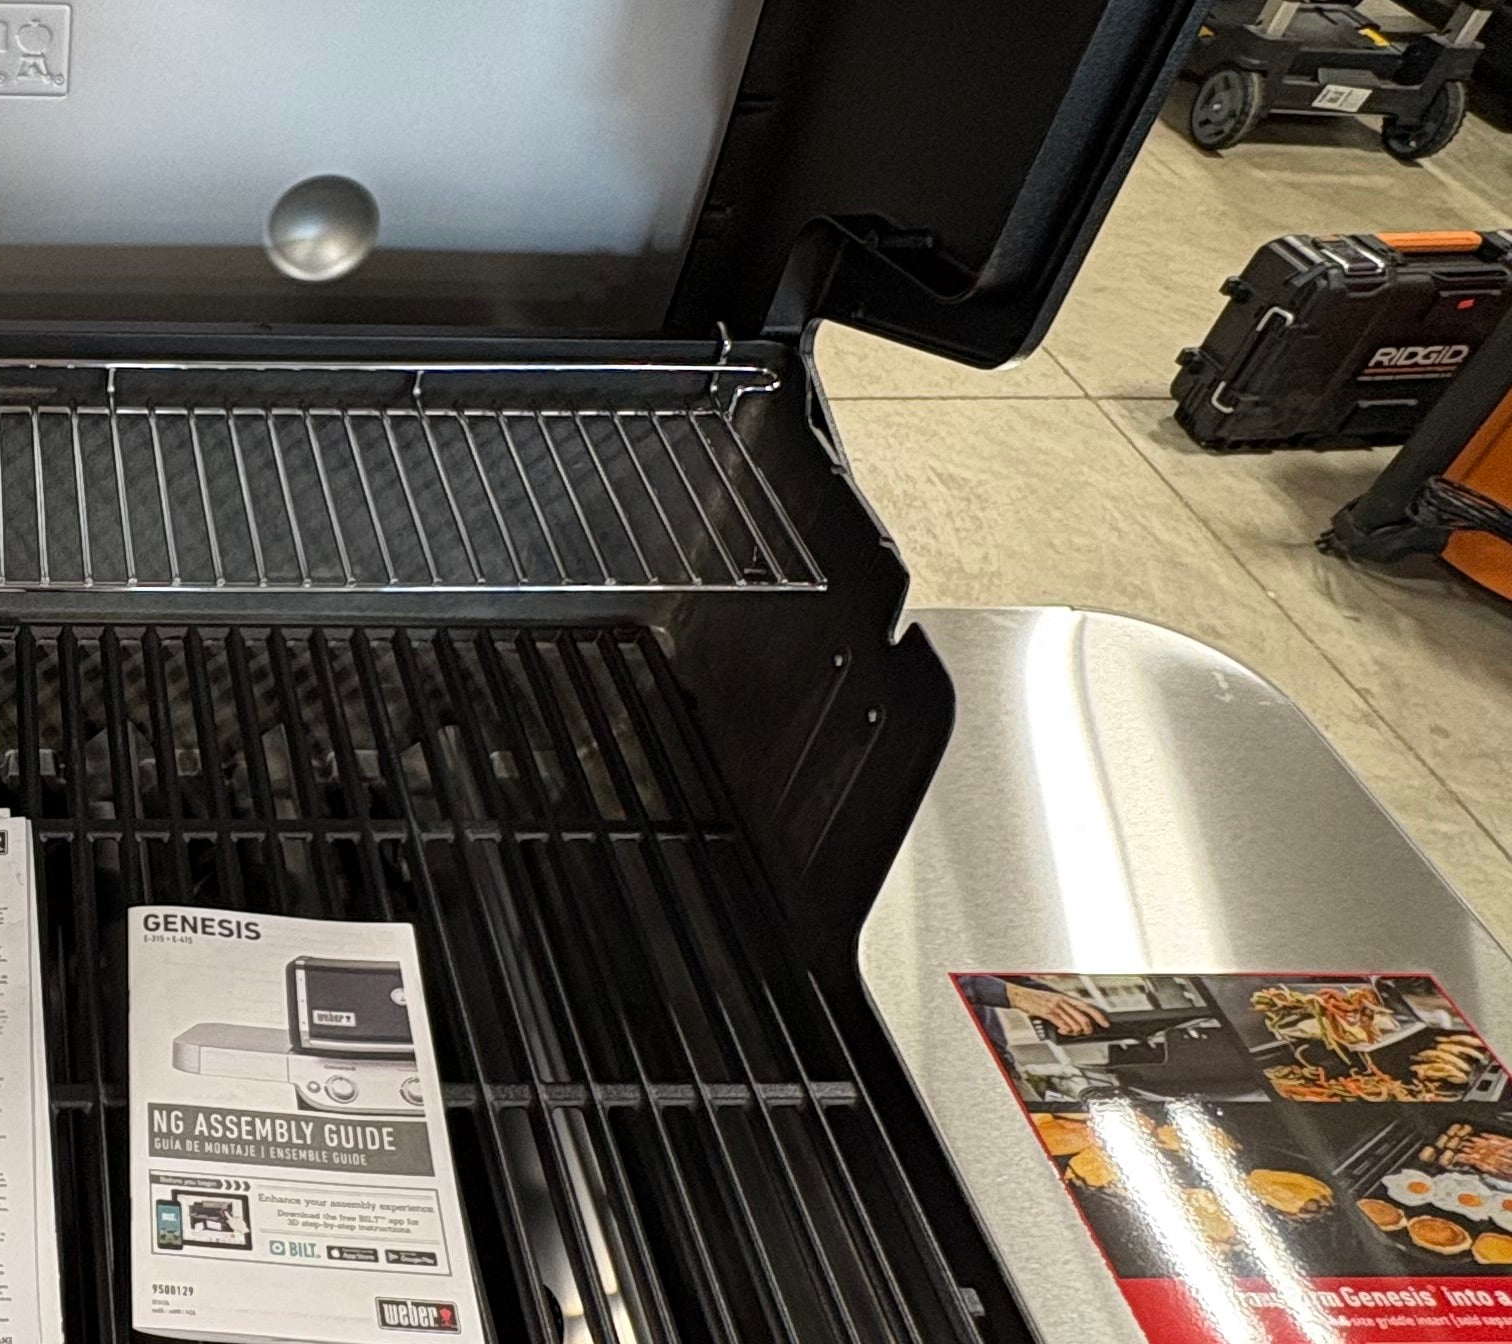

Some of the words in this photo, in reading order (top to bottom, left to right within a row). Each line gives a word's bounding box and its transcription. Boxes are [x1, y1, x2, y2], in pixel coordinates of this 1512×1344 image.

[1368, 345, 1470, 367] RIDGID
[142, 914, 262, 941] GENESIS
[153, 1109, 184, 1134] NG
[194, 1112, 314, 1145] ASSEMBLY
[324, 1123, 396, 1151] GUIDE
[154, 1136, 182, 1150] GUÍA
[186, 1139, 200, 1152] DE
[204, 1141, 256, 1157] MONTAJE
[270, 1146, 328, 1163] ENSEMBLE
[332, 1152, 367, 1166] GUIDE
[304, 1198, 327, 1208] your
[289, 1241, 316, 1258] BILT
[152, 1284, 194, 1296] 9500129
[1440, 1286, 1495, 1307] into
[382, 1300, 438, 1328] weber
